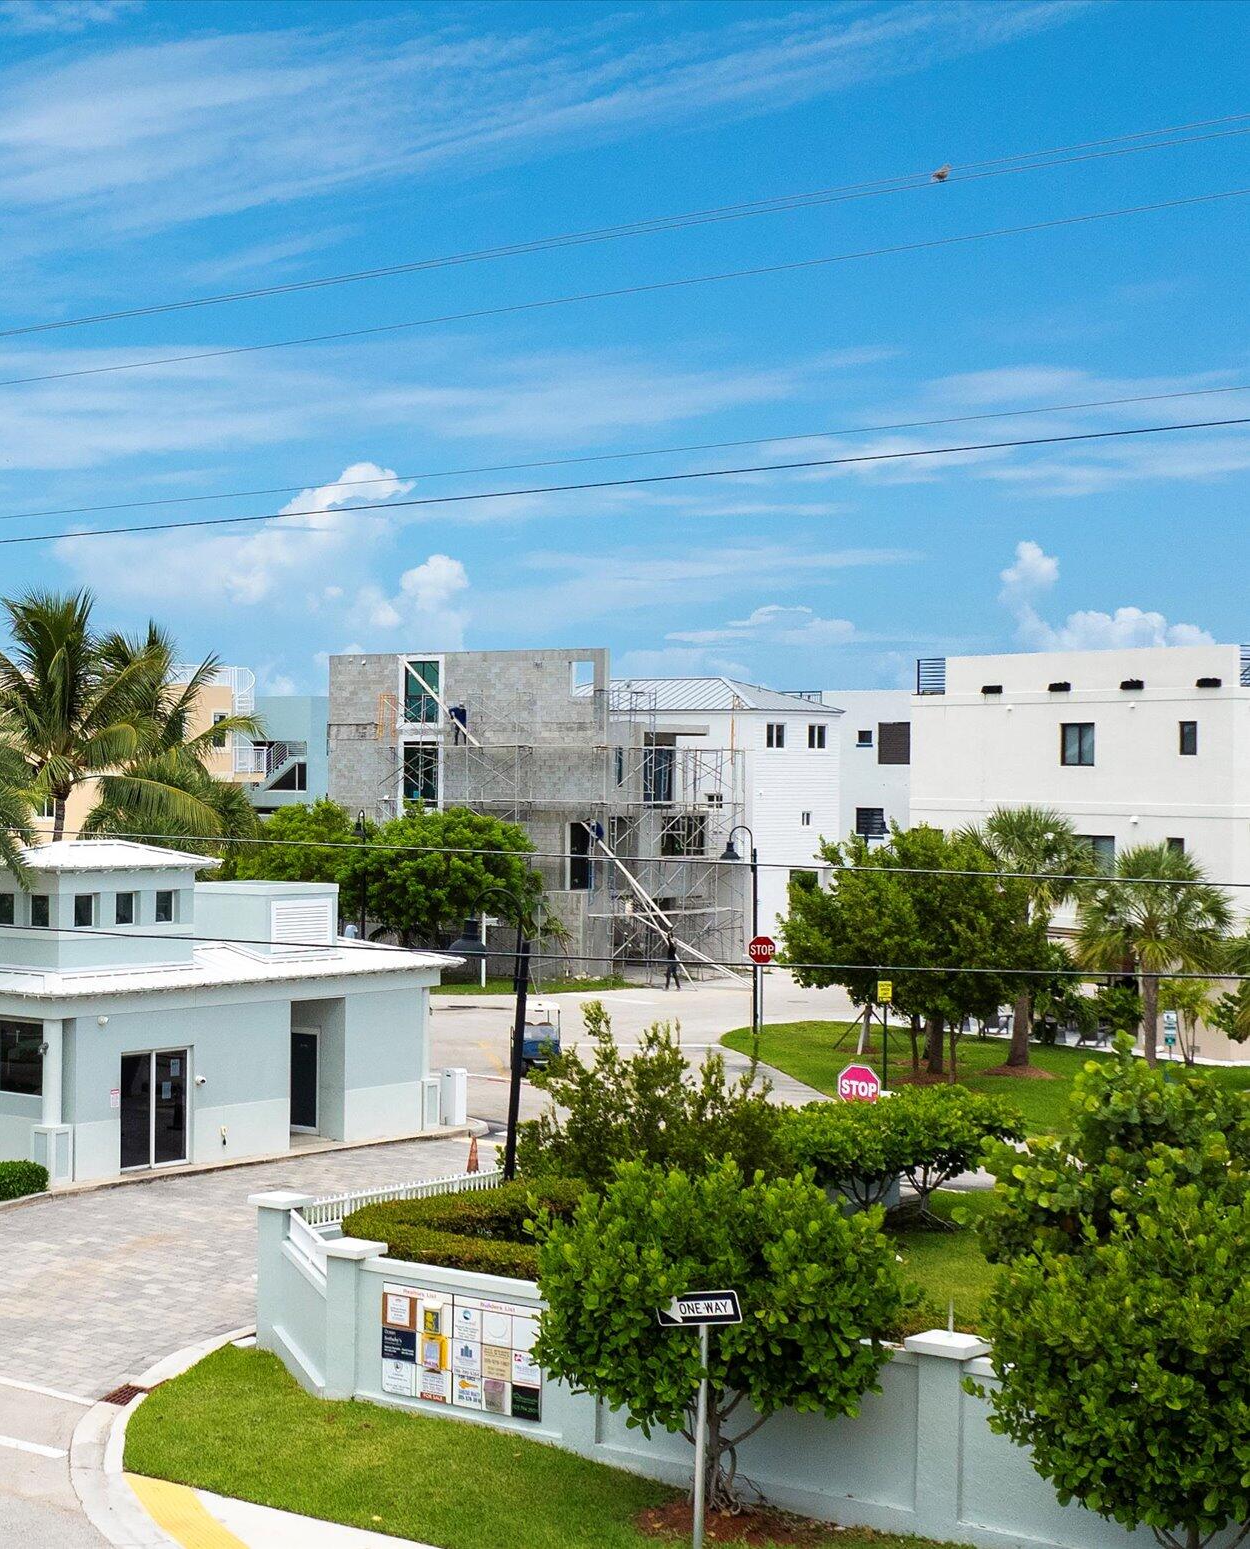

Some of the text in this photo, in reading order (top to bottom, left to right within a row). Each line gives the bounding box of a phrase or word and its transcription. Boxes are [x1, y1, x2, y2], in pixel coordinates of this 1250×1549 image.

[750, 945, 775, 955] STOP
[841, 1079, 877, 1098] STOP
[679, 1301, 728, 1315] ONE WAY
